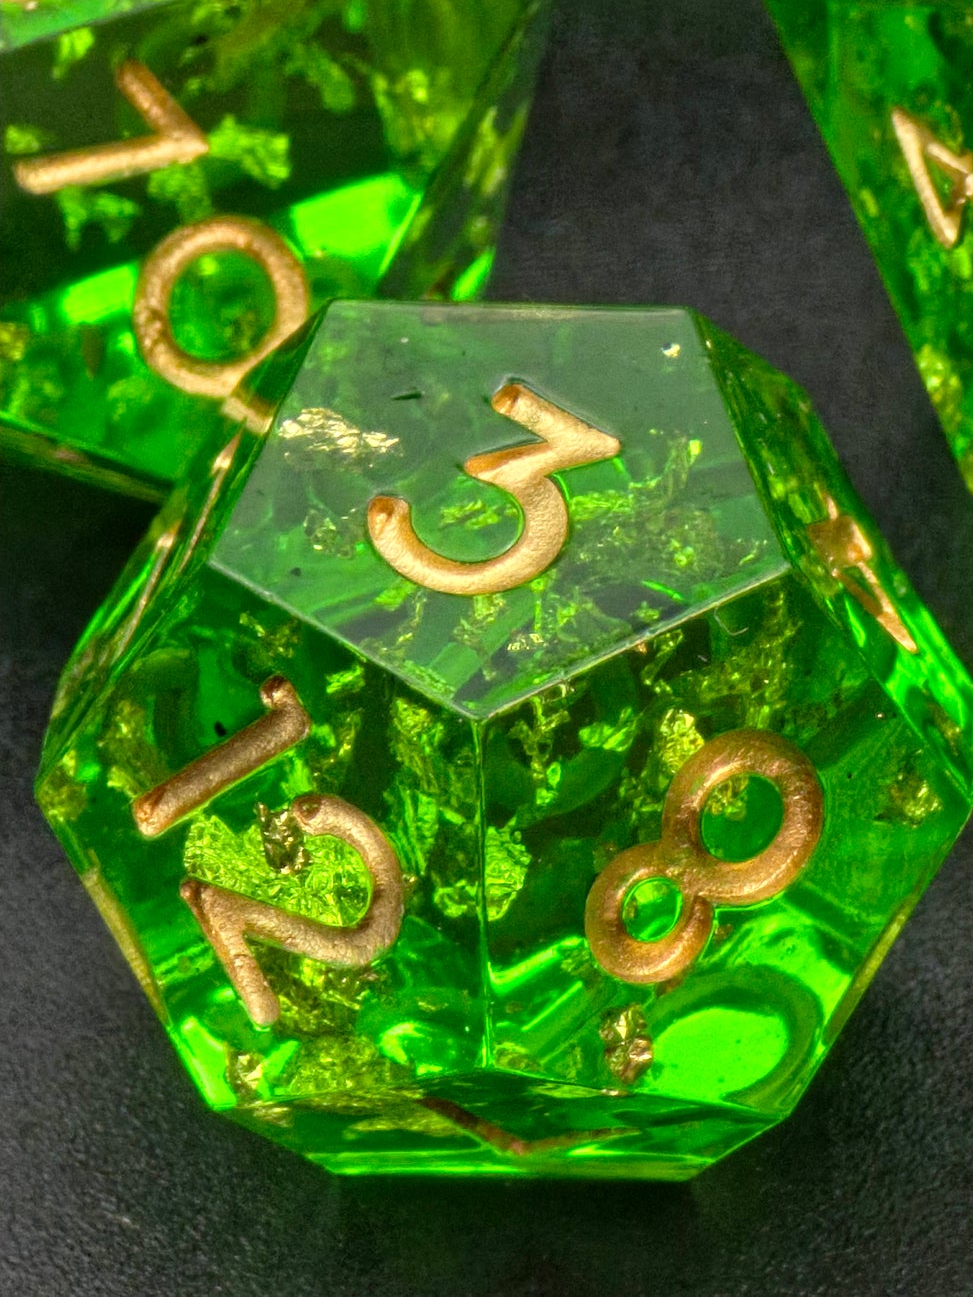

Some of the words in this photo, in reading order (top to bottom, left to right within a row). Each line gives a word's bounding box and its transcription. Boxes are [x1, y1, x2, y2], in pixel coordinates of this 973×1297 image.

[366, 382, 623, 597] 3
[133, 674, 404, 1029] 12
[586, 727, 826, 984] 8
